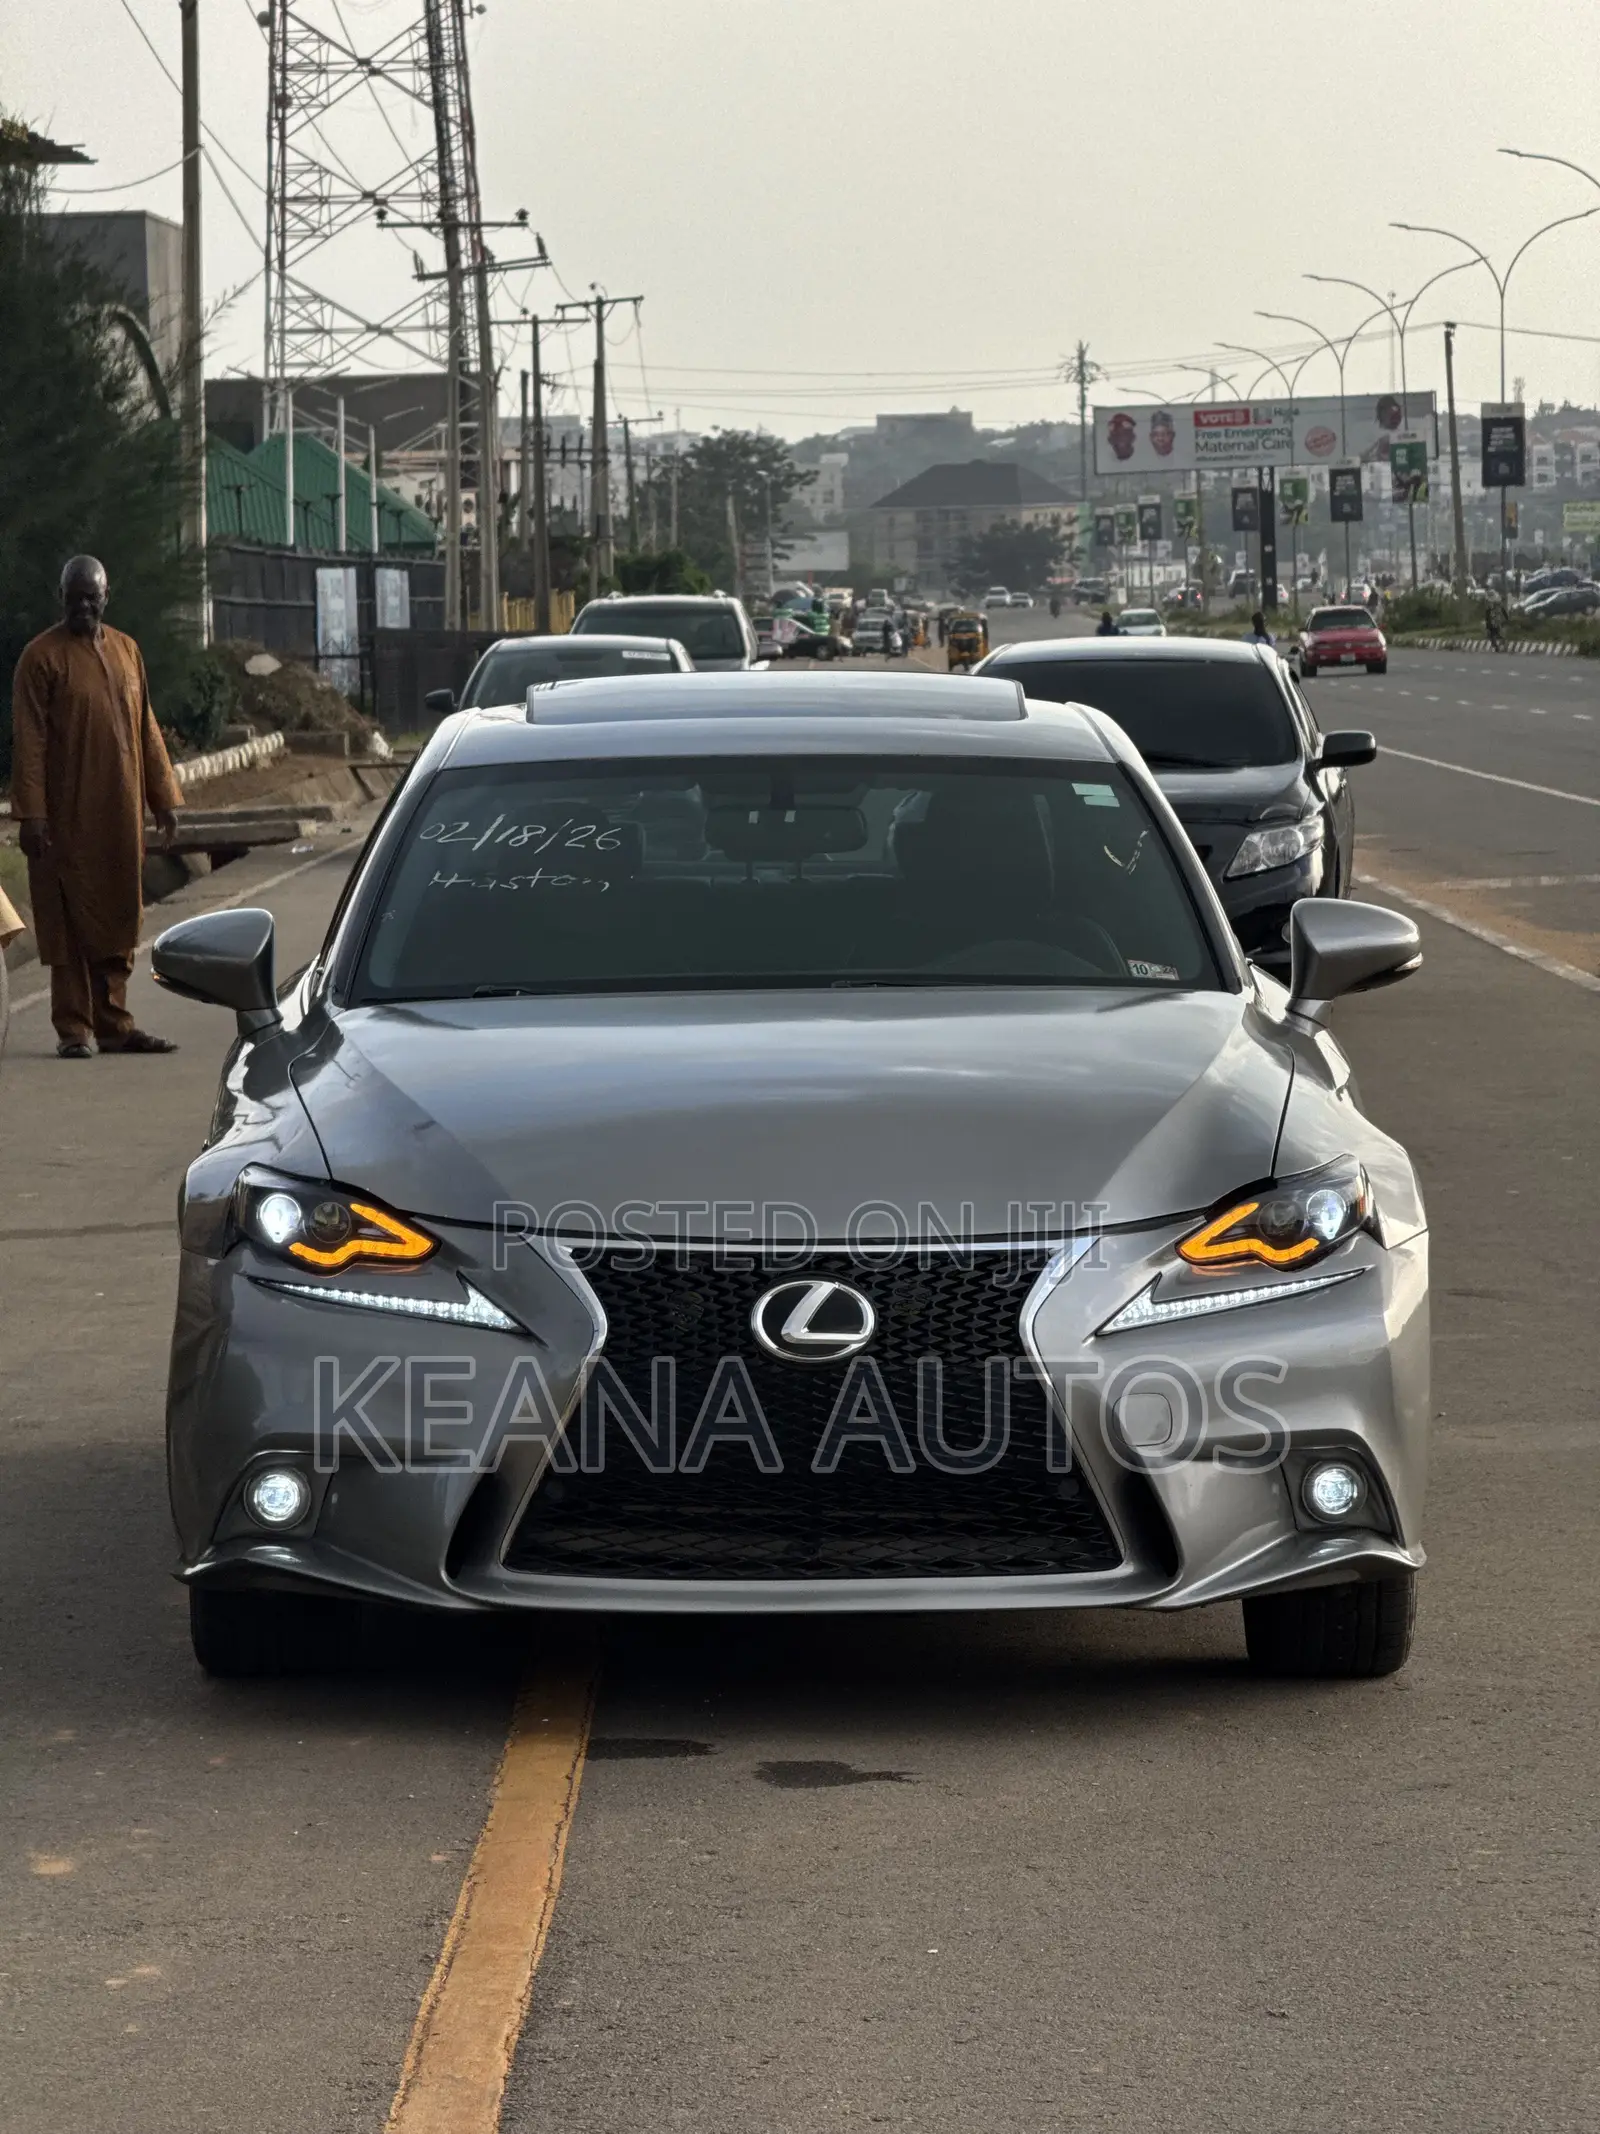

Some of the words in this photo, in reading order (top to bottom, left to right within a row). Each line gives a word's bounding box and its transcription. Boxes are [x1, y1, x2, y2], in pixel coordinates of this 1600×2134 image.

[1195, 429, 1221, 440] Free
[1224, 426, 1292, 439] Emergency
[1195, 440, 1259, 453] Maternal
[1261, 438, 1294, 450] Care
[418, 813, 622, 855] 02/18/26
[1132, 963, 1149, 976] 10
